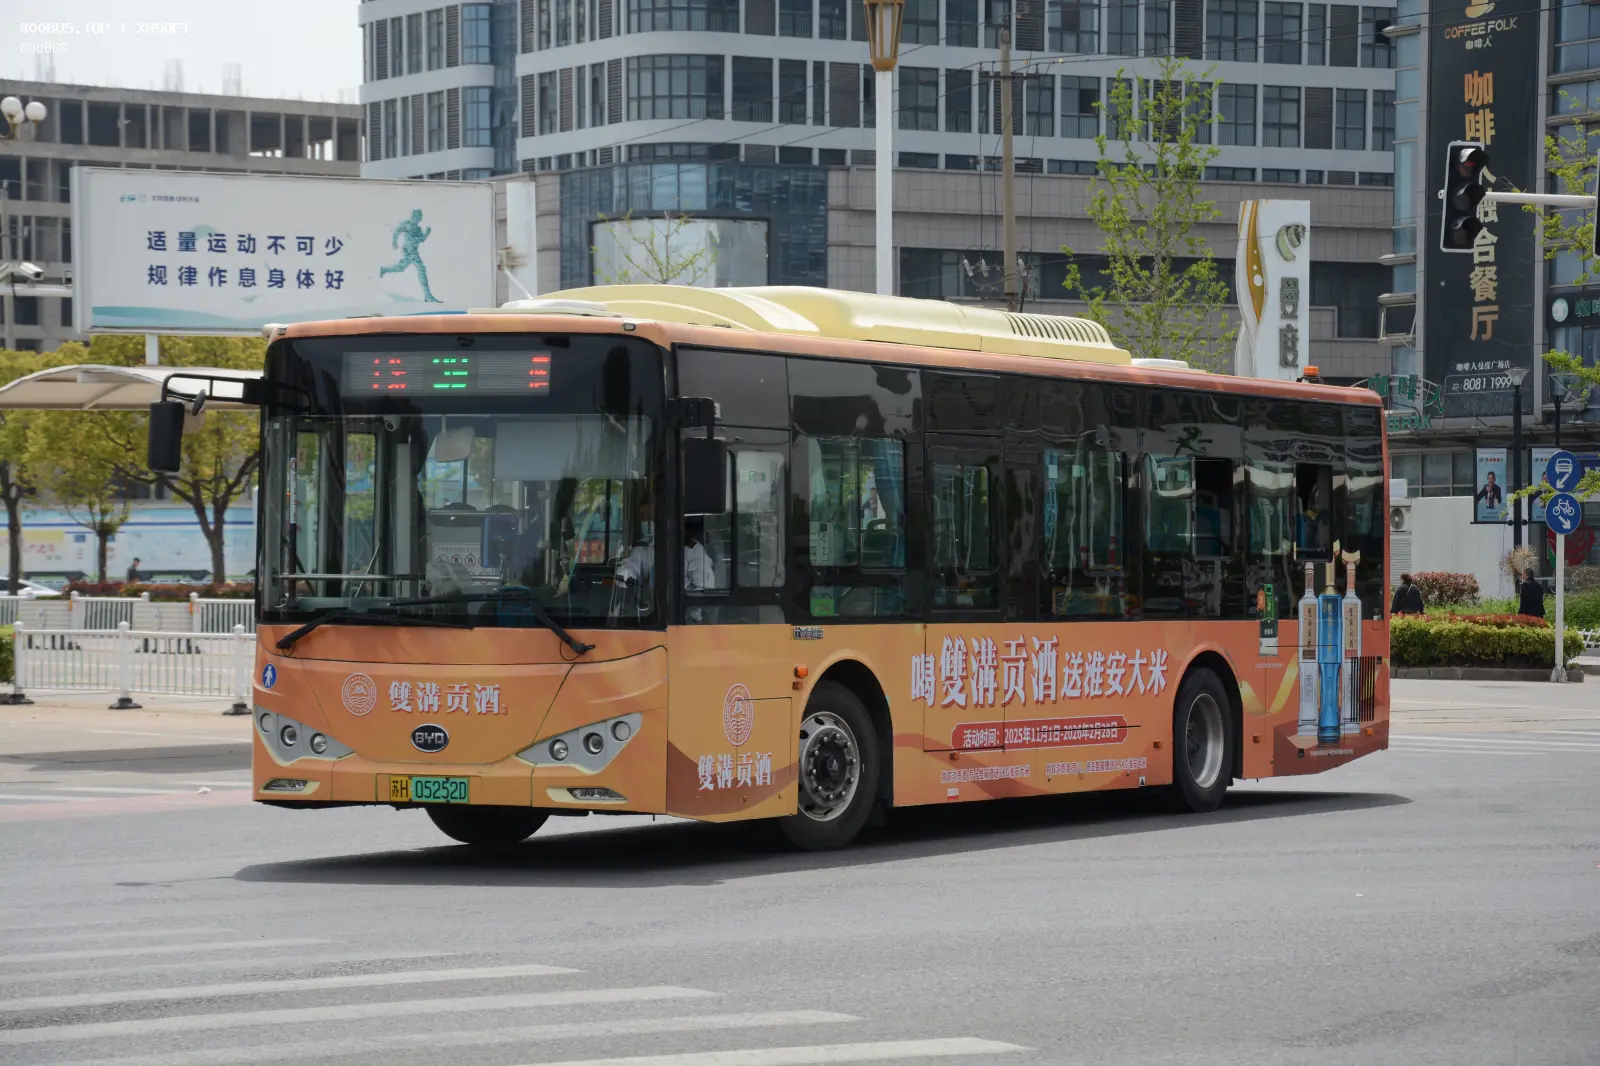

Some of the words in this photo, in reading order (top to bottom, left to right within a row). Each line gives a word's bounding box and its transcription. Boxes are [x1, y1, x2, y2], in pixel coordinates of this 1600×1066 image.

[1444, 21, 1486, 39] COFFEE
[1487, 16, 1518, 34] FOLK
[1465, 38, 1492, 50] 咖啡人
[147, 230, 344, 256] 适量运动不可少
[147, 264, 344, 289] 规律作息身体好
[1463, 377, 1486, 391] 8081
[1490, 376, 1512, 389] 1999
[415, 732, 445, 744] BYD
[392, 780, 408, 798] 苏H
[415, 780, 467, 800] 05252D
